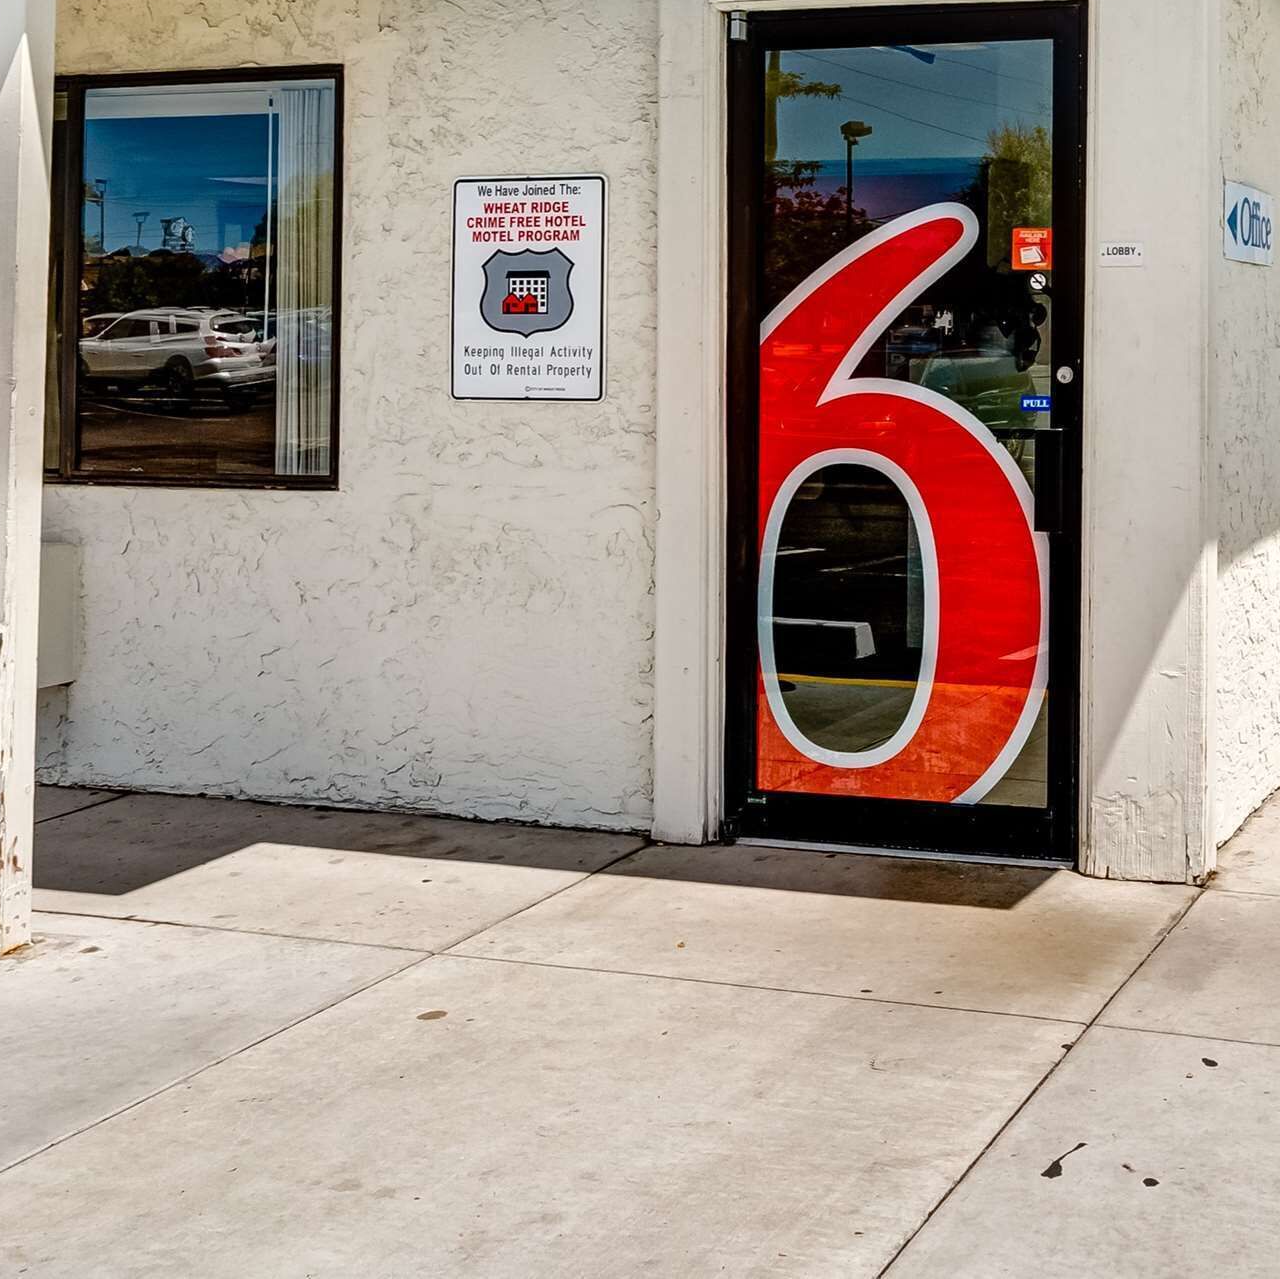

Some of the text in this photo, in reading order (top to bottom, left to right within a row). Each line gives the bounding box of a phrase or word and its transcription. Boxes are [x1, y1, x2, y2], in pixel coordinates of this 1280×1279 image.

[477, 183, 581, 197] We Have Joined The:
[483, 201, 569, 214] WHEAT RIDGE
[466, 215, 586, 228] CRIME FREE HOTEL
[1240, 196, 1272, 250] Office
[472, 230, 580, 242] MOTEL PROGRAM
[1106, 246, 1137, 256] LOBBY
[464, 346, 593, 360] Keeping Illegal Activity
[464, 363, 592, 378] Out Of Rental Property
[1023, 399, 1050, 408] PULL
[757, 202, 1050, 805] 6
